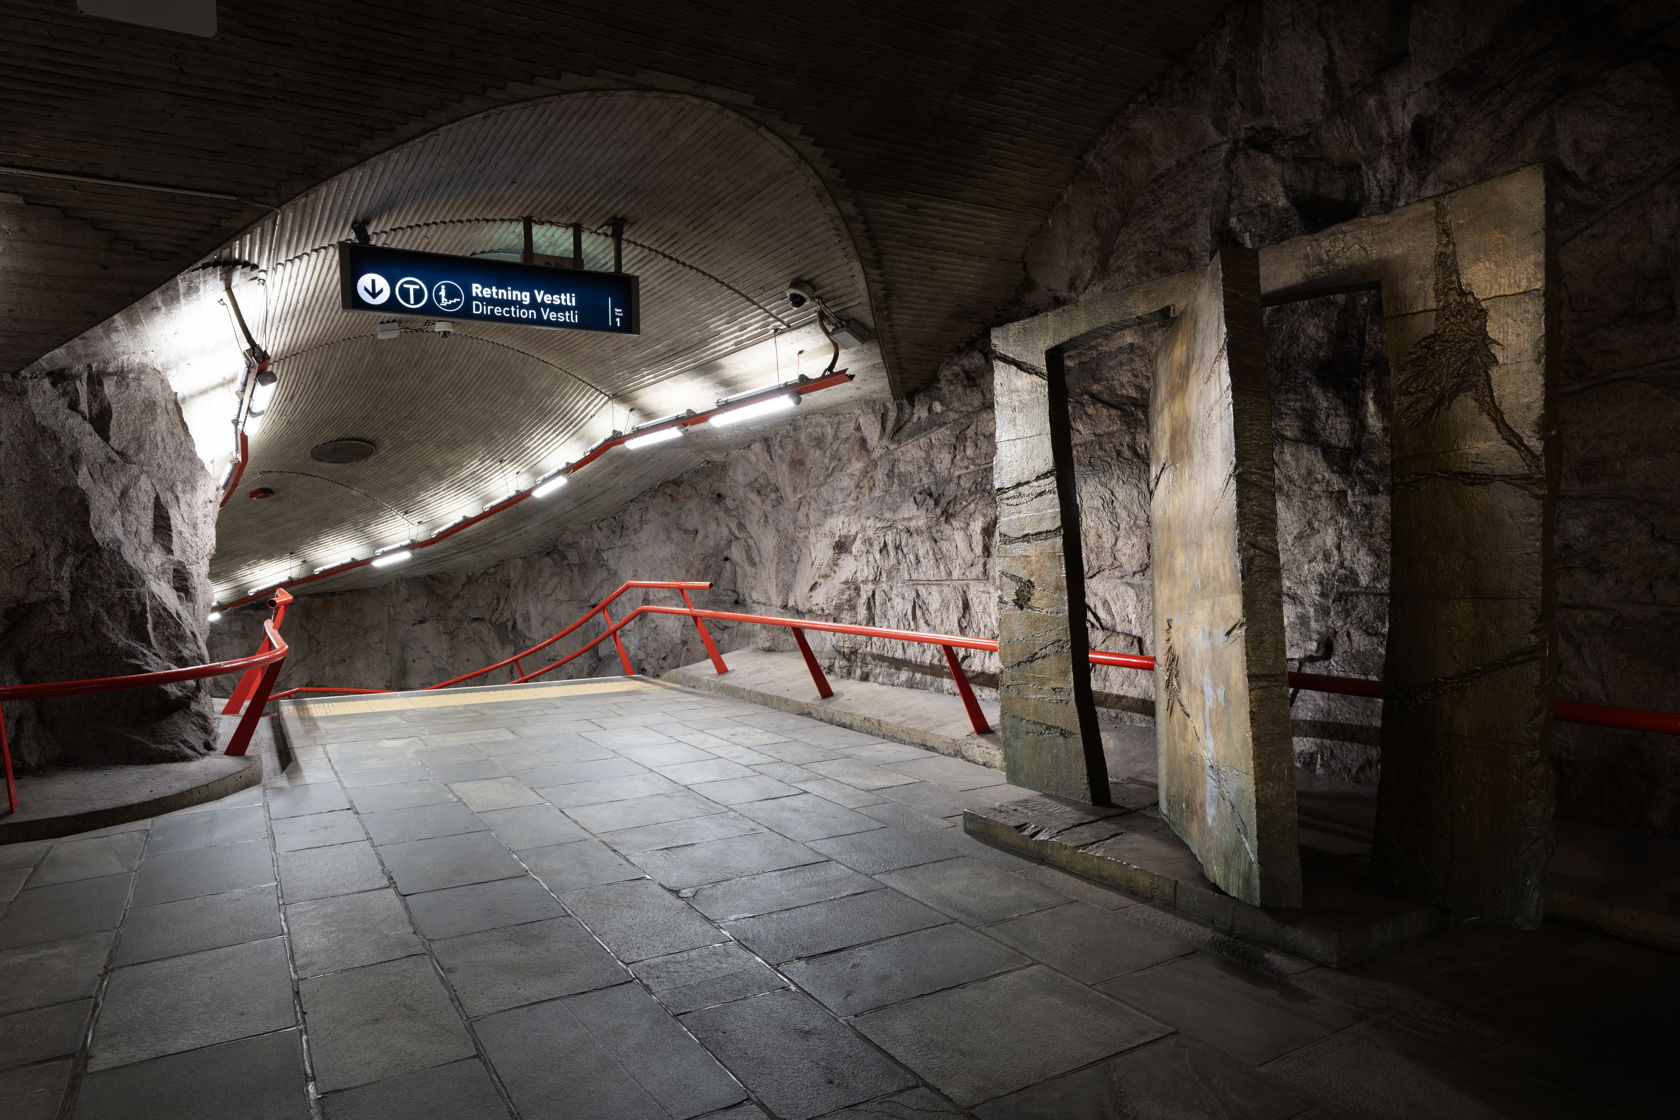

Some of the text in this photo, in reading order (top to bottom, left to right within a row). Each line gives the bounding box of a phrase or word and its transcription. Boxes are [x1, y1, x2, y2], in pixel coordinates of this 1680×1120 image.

[402, 283, 420, 304] T
[472, 283, 576, 306] Retning Vestli
[472, 301, 579, 323] Direction Vestli
[615, 317, 621, 327] 1
